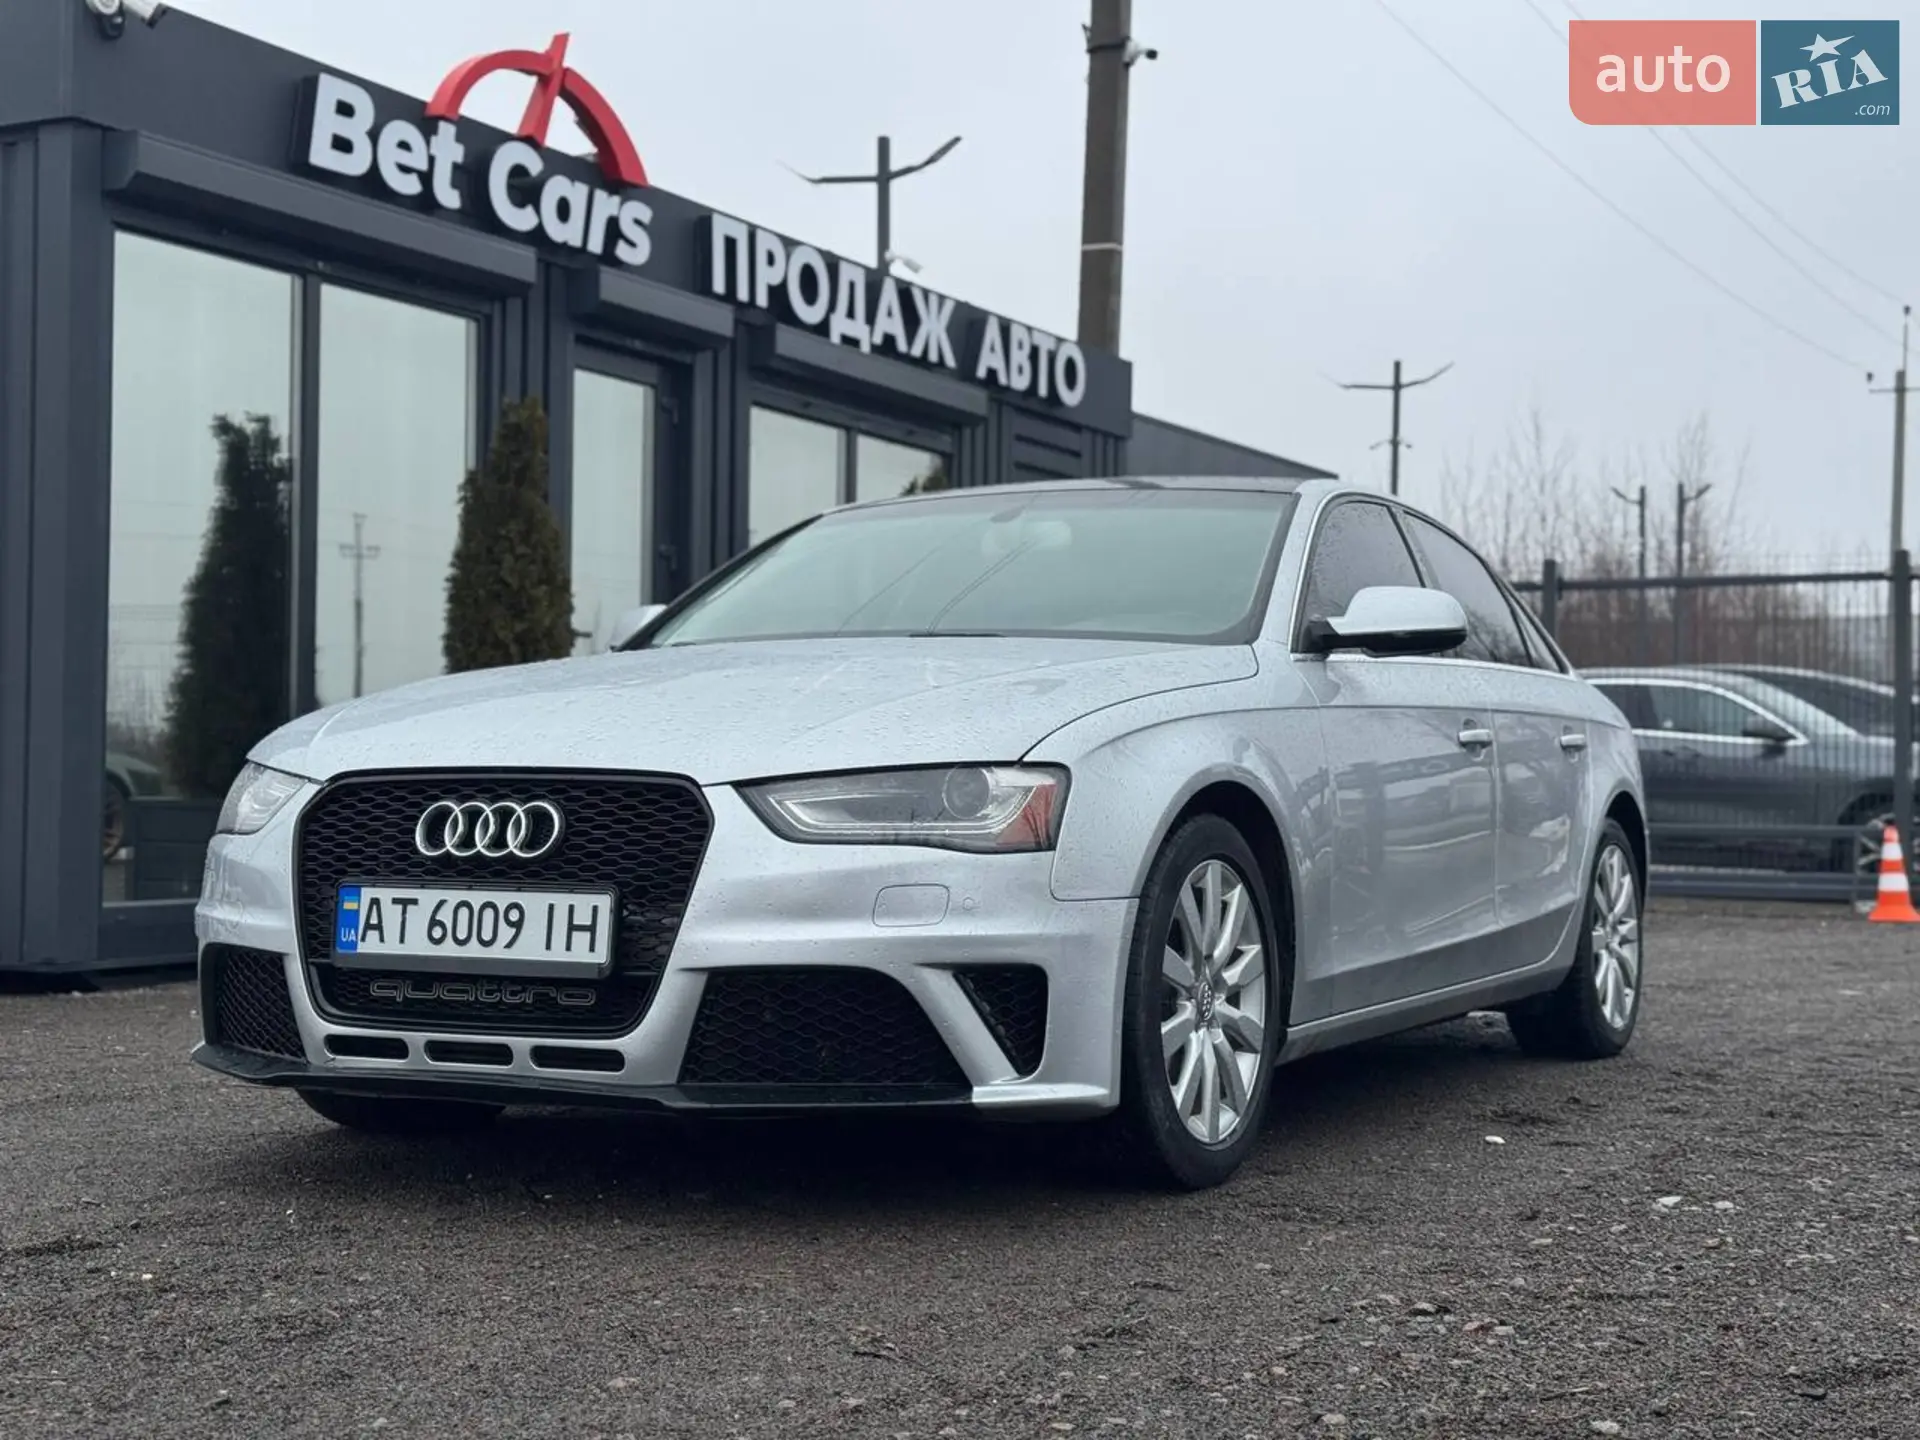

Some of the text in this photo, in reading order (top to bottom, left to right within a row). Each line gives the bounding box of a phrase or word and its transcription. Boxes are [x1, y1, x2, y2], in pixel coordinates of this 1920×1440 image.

[309, 72, 653, 266] Bet Cars
[711, 212, 1087, 407] ПРОДАЖ АВТО
[341, 926, 357, 943] UA
[360, 897, 599, 952] AT 6009 IH
[369, 977, 597, 1006] quattro
